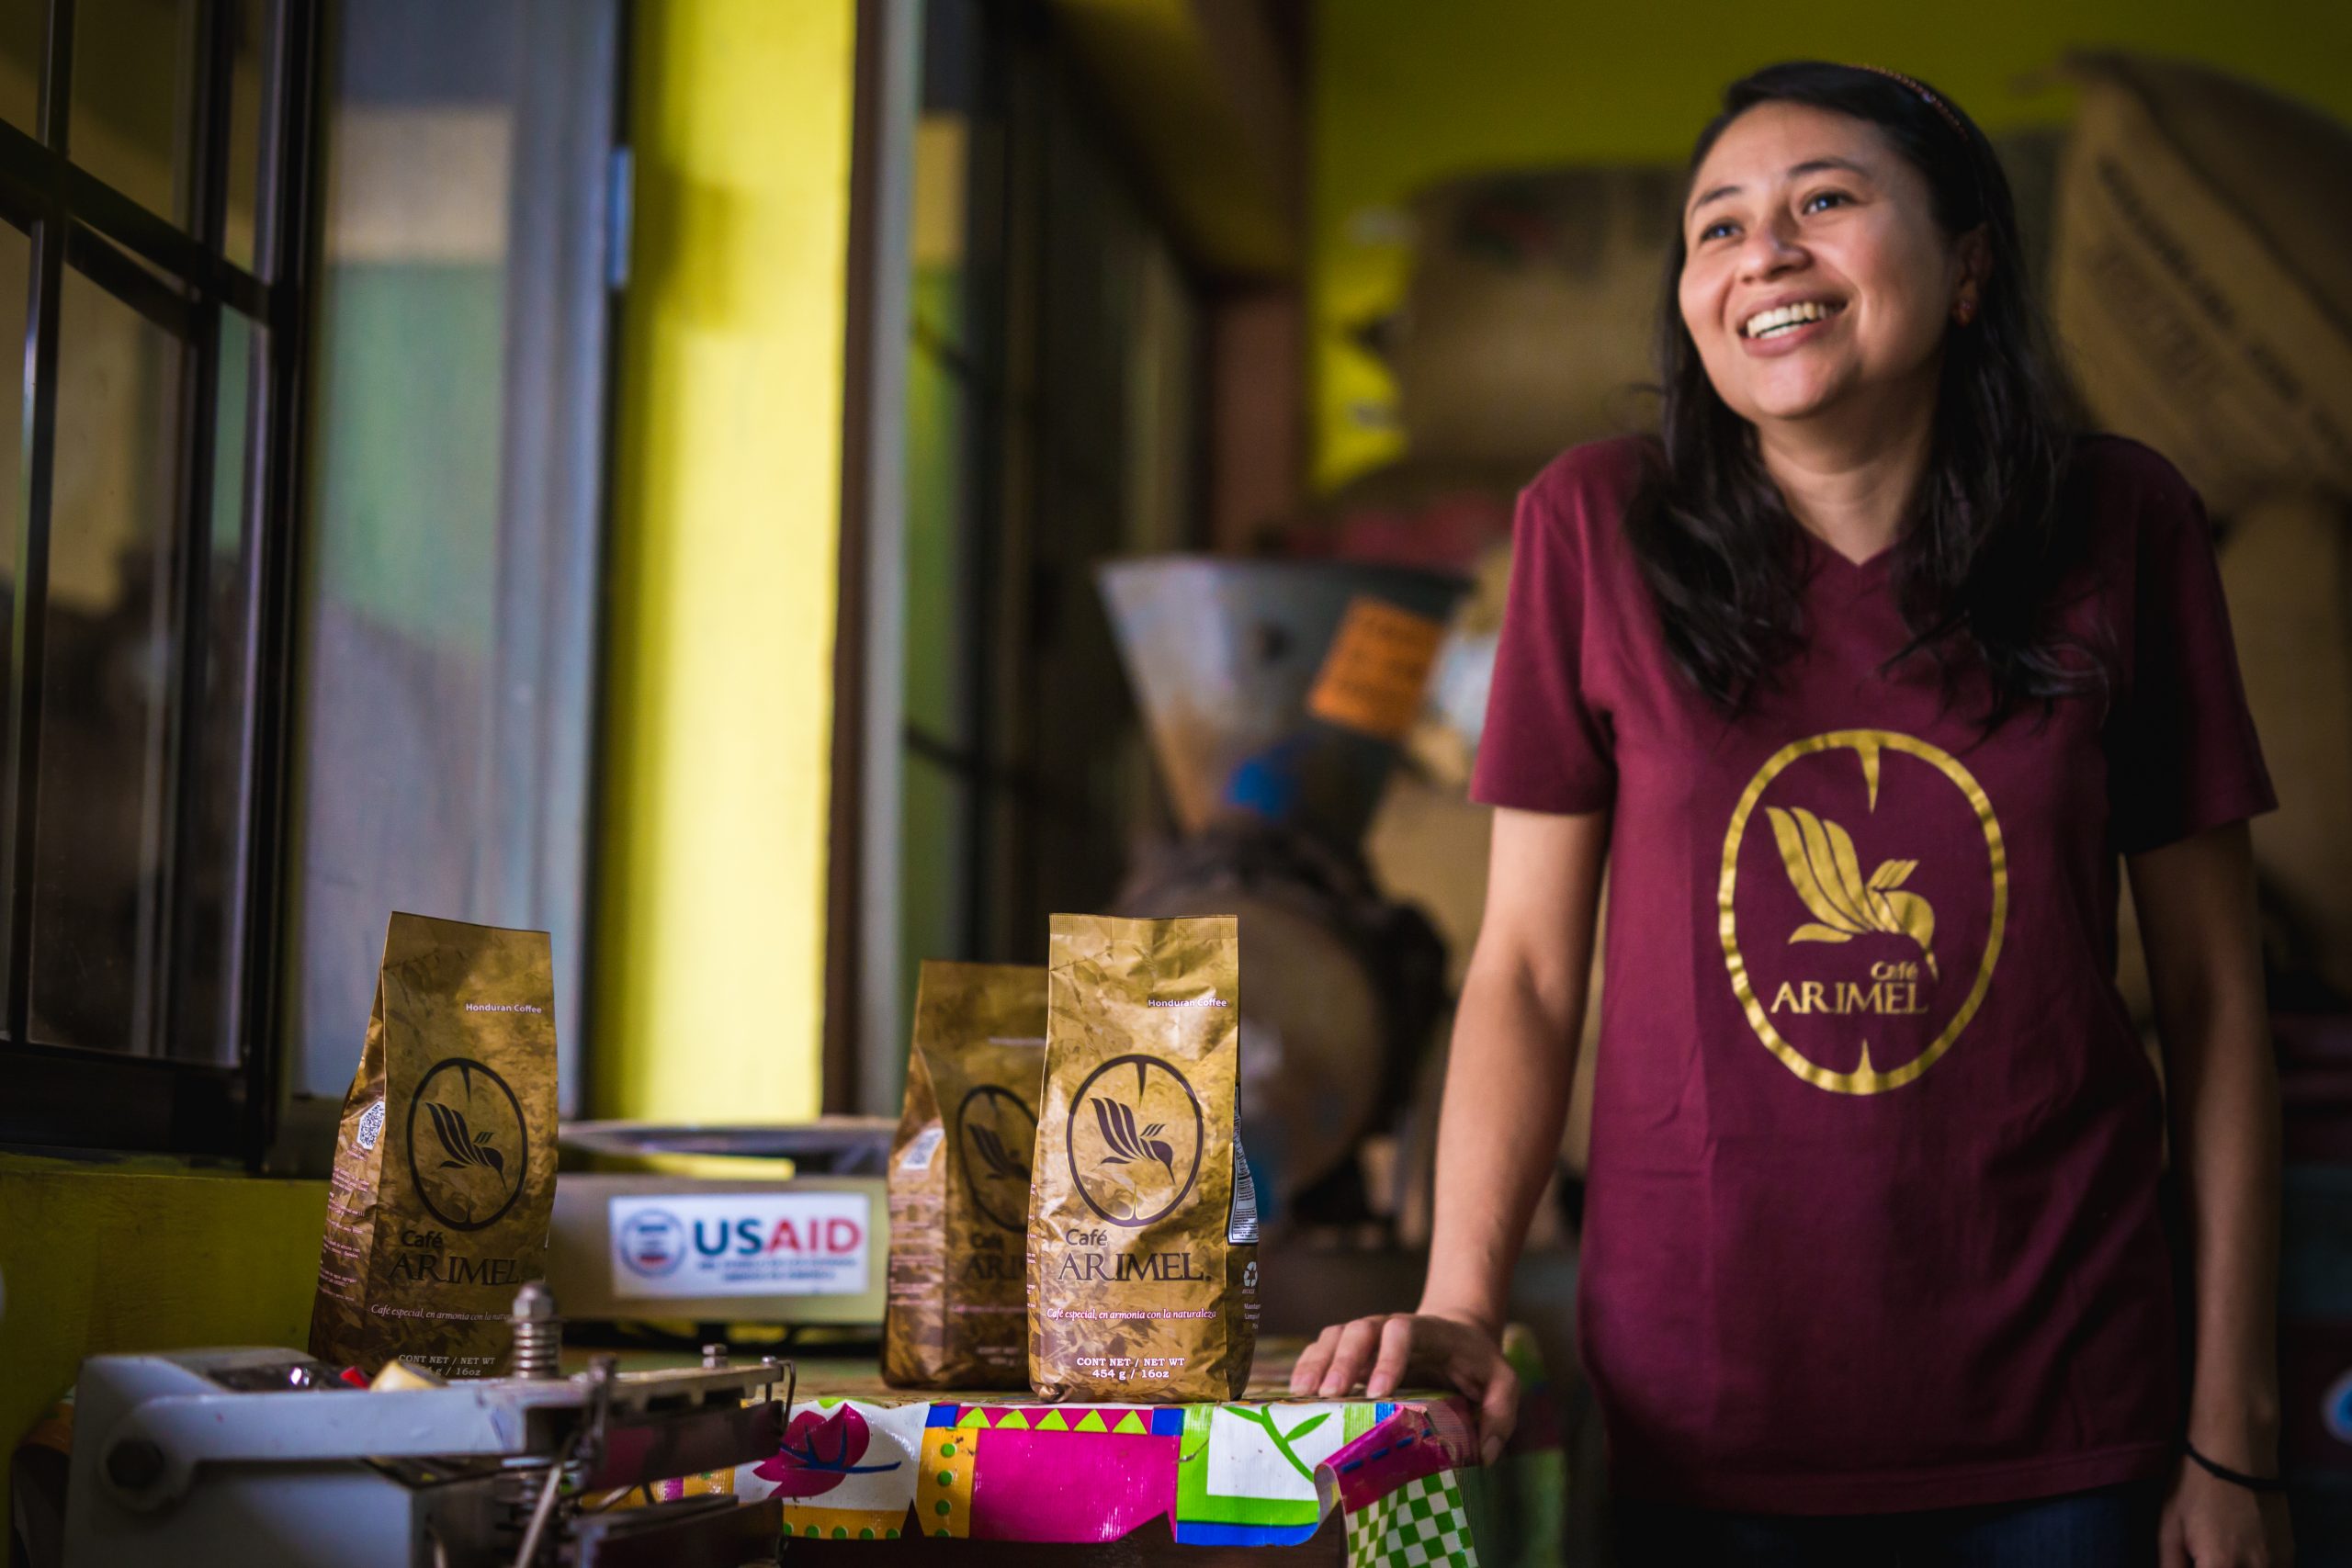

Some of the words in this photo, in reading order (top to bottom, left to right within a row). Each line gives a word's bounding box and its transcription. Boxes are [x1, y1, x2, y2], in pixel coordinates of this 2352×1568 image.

[1871, 961, 1919, 981] Café
[1148, 999, 1195, 1008] Honduran
[1196, 998, 1227, 1008] Coffee
[1770, 981, 1929, 1014] ARIMEL
[465, 1002, 512, 1012] Honduran
[514, 1004, 542, 1014] Coffee
[401, 1229, 444, 1250] Café
[695, 1219, 862, 1257] USAID
[1066, 1228, 1108, 1247] Café
[371, 1304, 390, 1315] Café
[484, 1312, 492, 1321] la
[1046, 1308, 1064, 1321] Café
[1065, 1309, 1097, 1321] especial,
[1163, 1309, 1171, 1319] la
[1172, 1308, 1216, 1319] naturaleza
[399, 1354, 427, 1364] CONT
[429, 1355, 450, 1365] NET
[460, 1357, 480, 1365] NET
[482, 1357, 496, 1365] WT
[1076, 1358, 1107, 1366] CONT
[1109, 1358, 1131, 1367] NET
[1143, 1358, 1166, 1367] NET
[1169, 1358, 1185, 1367] WT
[455, 1367, 481, 1376] 16oz
[1091, 1369, 1115, 1379] 454
[1118, 1371, 1126, 1381] g
[1141, 1369, 1170, 1379] 16oz
